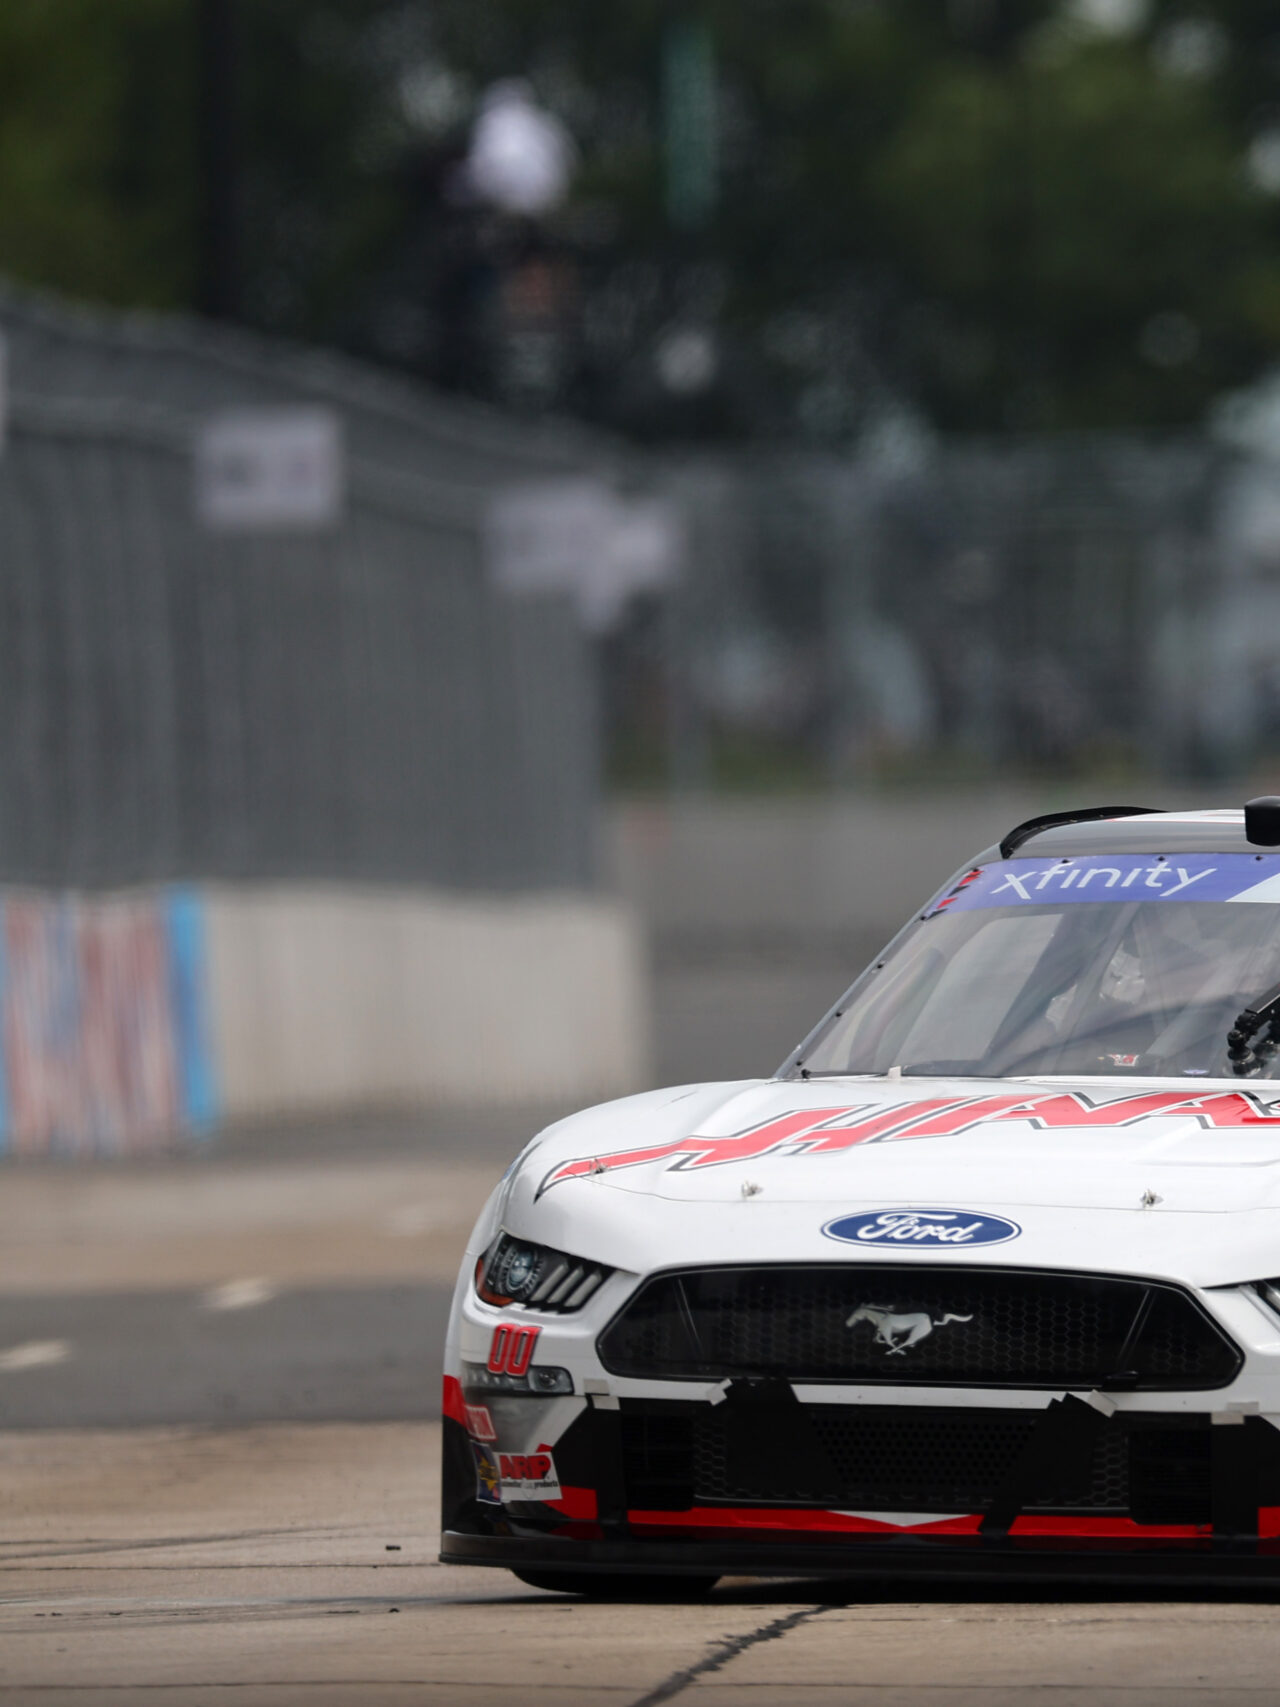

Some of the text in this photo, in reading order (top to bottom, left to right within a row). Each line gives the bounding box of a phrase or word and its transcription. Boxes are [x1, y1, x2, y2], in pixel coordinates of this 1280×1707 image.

[990, 861, 1217, 900] xfinity
[857, 1212, 984, 1243] Ford
[487, 1323, 542, 1376] 00
[498, 1454, 552, 1480] ARP
